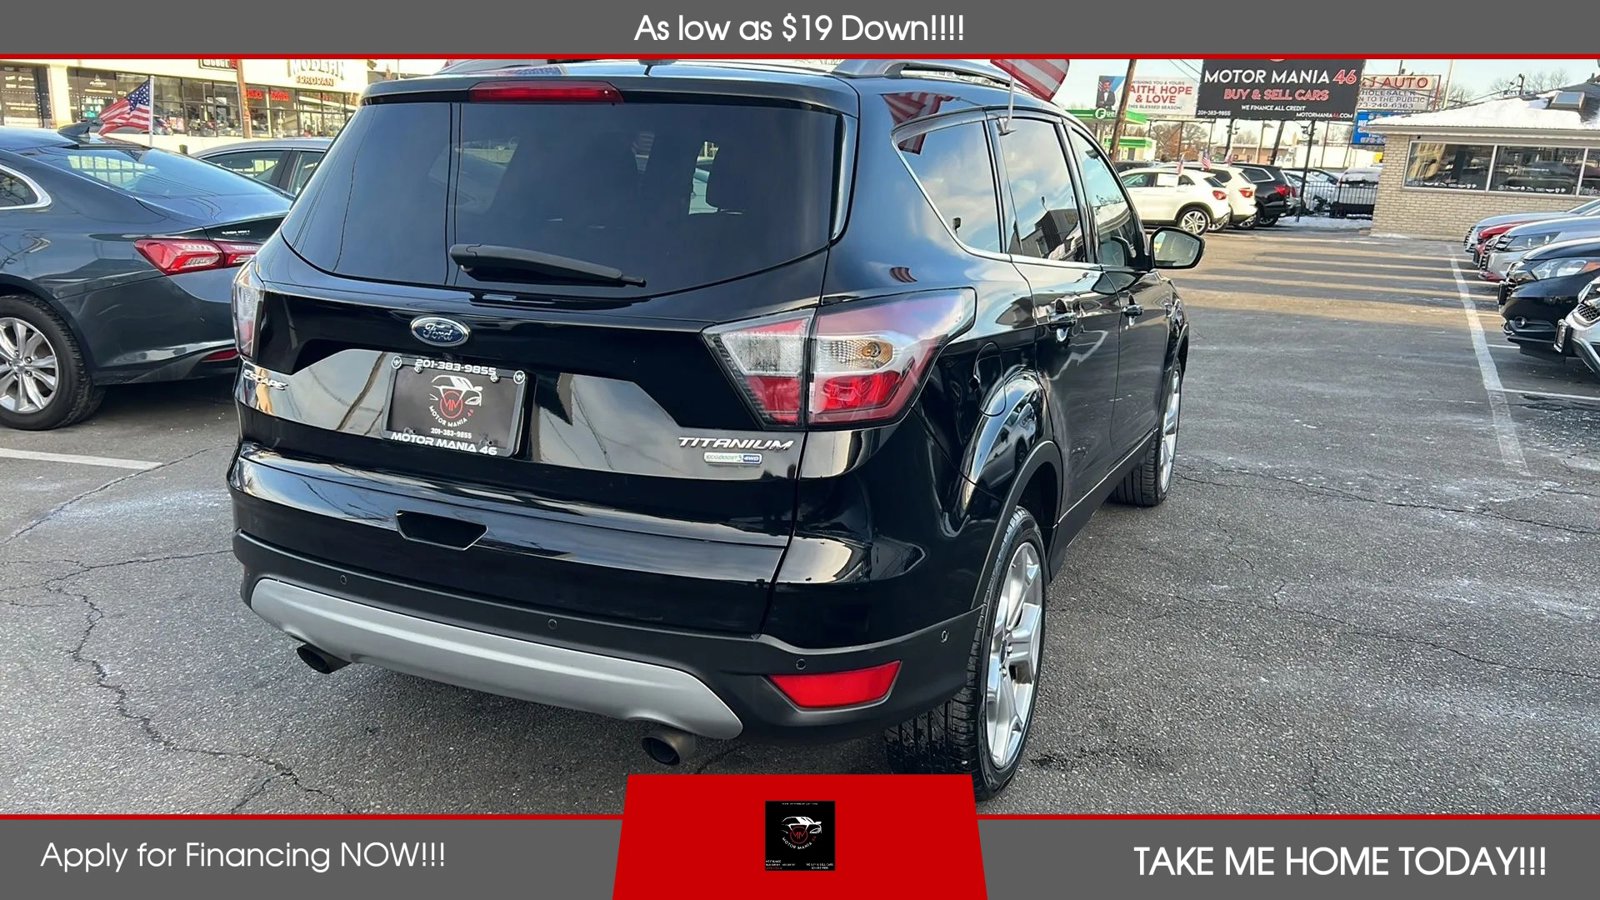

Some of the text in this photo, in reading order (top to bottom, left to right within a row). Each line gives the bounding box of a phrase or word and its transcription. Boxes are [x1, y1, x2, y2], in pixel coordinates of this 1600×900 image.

[1204, 69, 1357, 85] MOTOR MANIA 46
[1381, 76, 1429, 89] AUTO
[1160, 85, 1193, 96] HOPE
[1223, 88, 1330, 101] BUY & SELL CARS
[1135, 94, 1177, 104] & LOVE
[423, 322, 454, 341] Ford
[415, 359, 497, 376] 201-383-9855
[391, 432, 498, 456] MOTOR MANIA 46
[678, 437, 795, 451] TITANIUM
